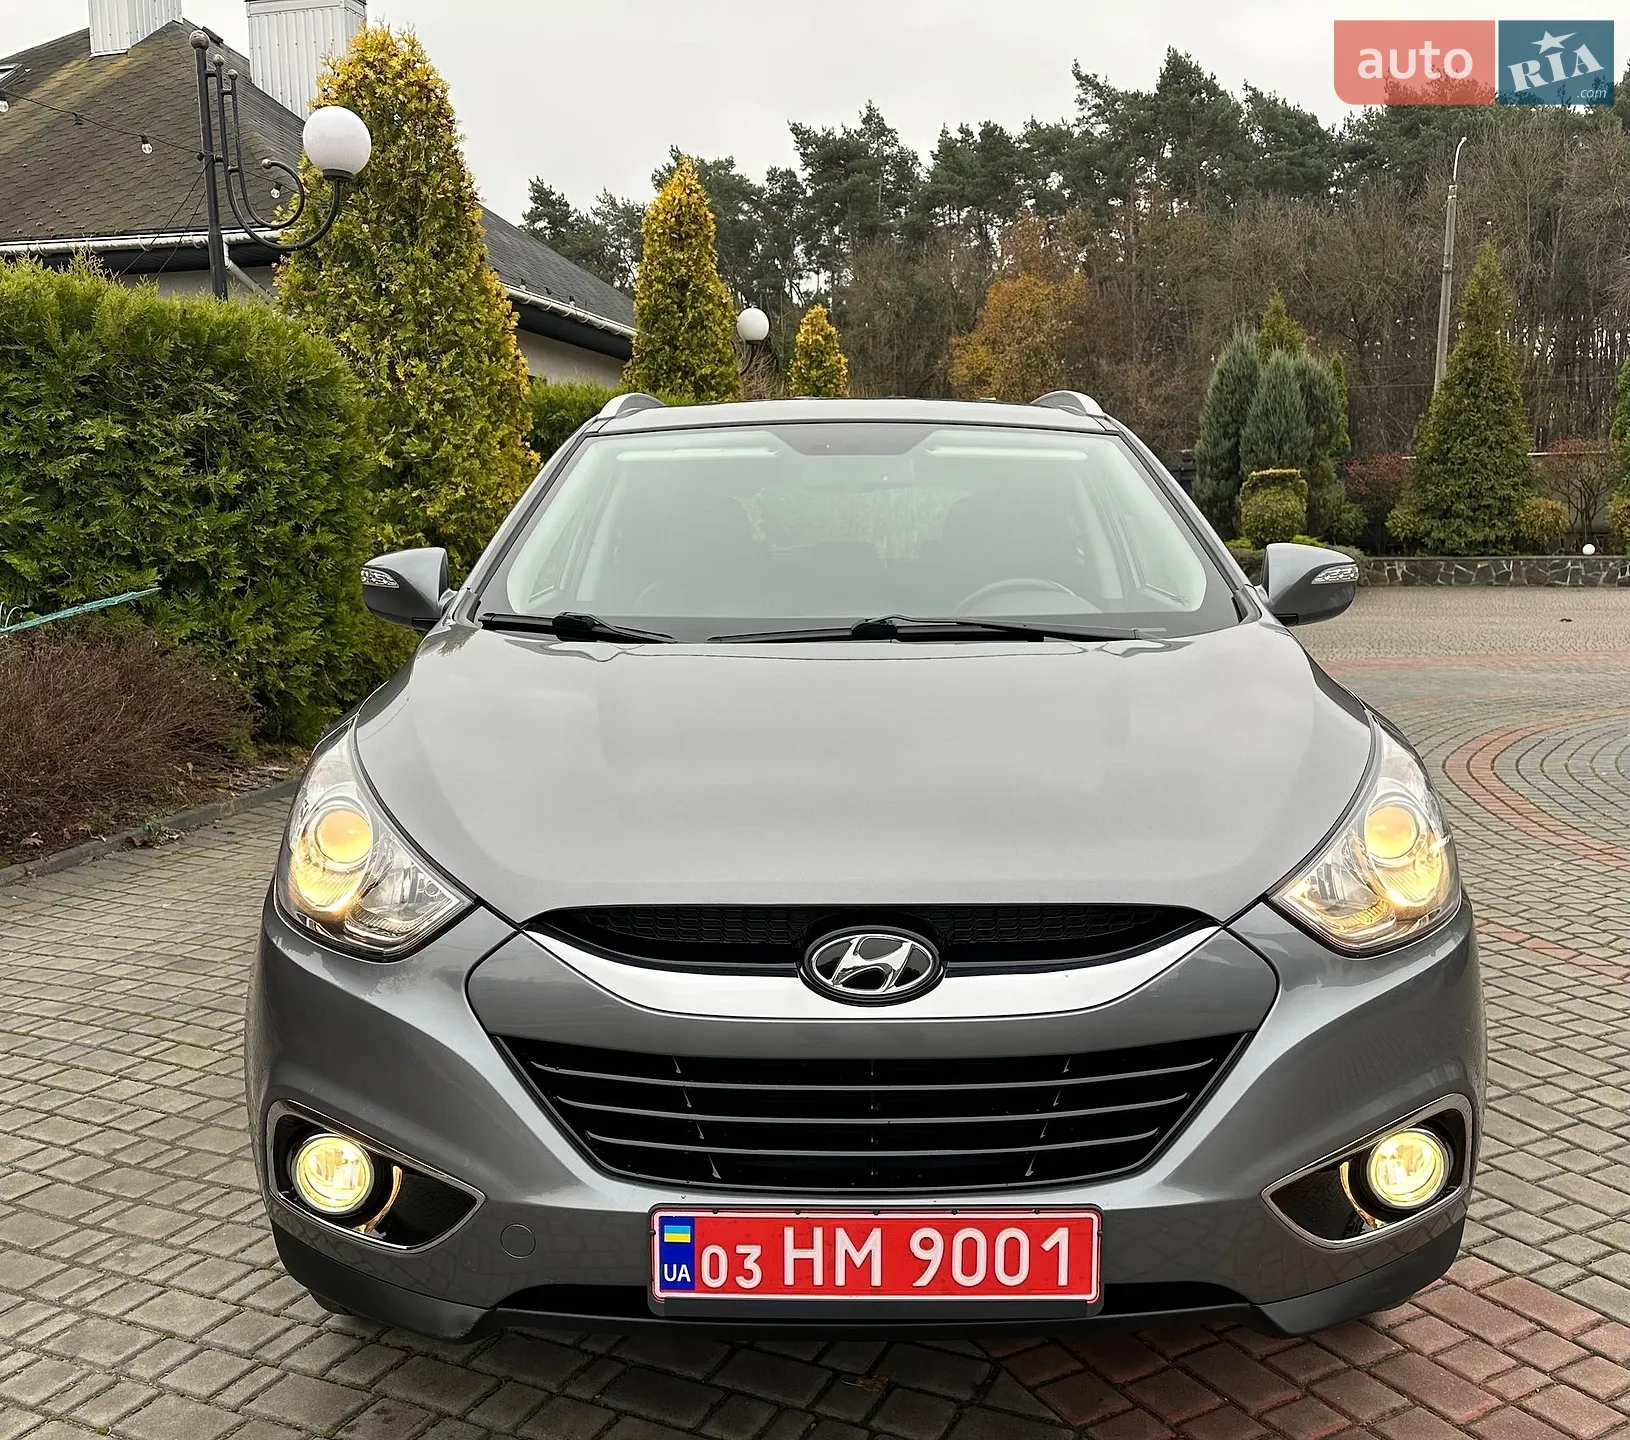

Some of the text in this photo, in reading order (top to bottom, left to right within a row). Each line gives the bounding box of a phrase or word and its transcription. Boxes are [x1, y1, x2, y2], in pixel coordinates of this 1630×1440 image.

[663, 1263, 691, 1283] UA
[700, 1226, 1070, 1288] 03 HM 9001
